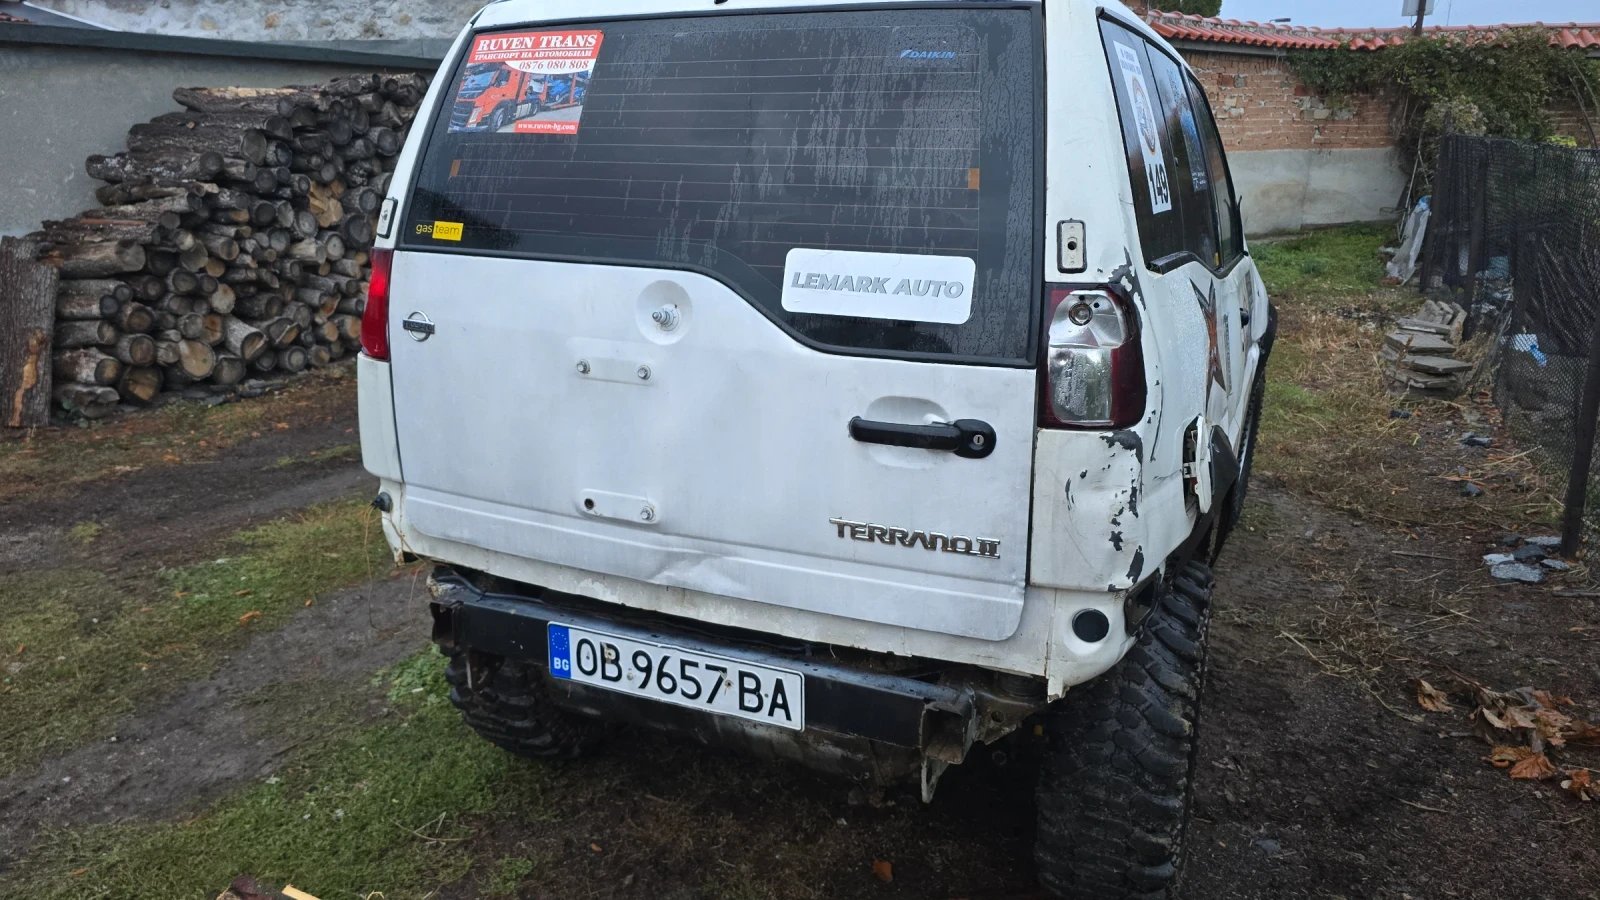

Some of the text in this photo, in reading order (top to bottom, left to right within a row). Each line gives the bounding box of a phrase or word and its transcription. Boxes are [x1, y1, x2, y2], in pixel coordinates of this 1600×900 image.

[478, 34, 598, 51] RUVEN TRANS
[474, 52, 520, 61] ТРАНСПОРТ
[533, 50, 592, 58] АВТОМОБИЛИ
[909, 51, 955, 59] DAIKIN
[519, 60, 589, 70] 0876 080 808
[518, 123, 576, 131] www.ruven-bg.com
[1148, 163, 1169, 206] 149
[416, 224, 460, 235] gas team
[791, 272, 964, 299] LEMARK AUTO
[829, 517, 1001, 559] TERRANO II
[553, 656, 570, 671] BG
[576, 637, 792, 721] OB 9657 BA
